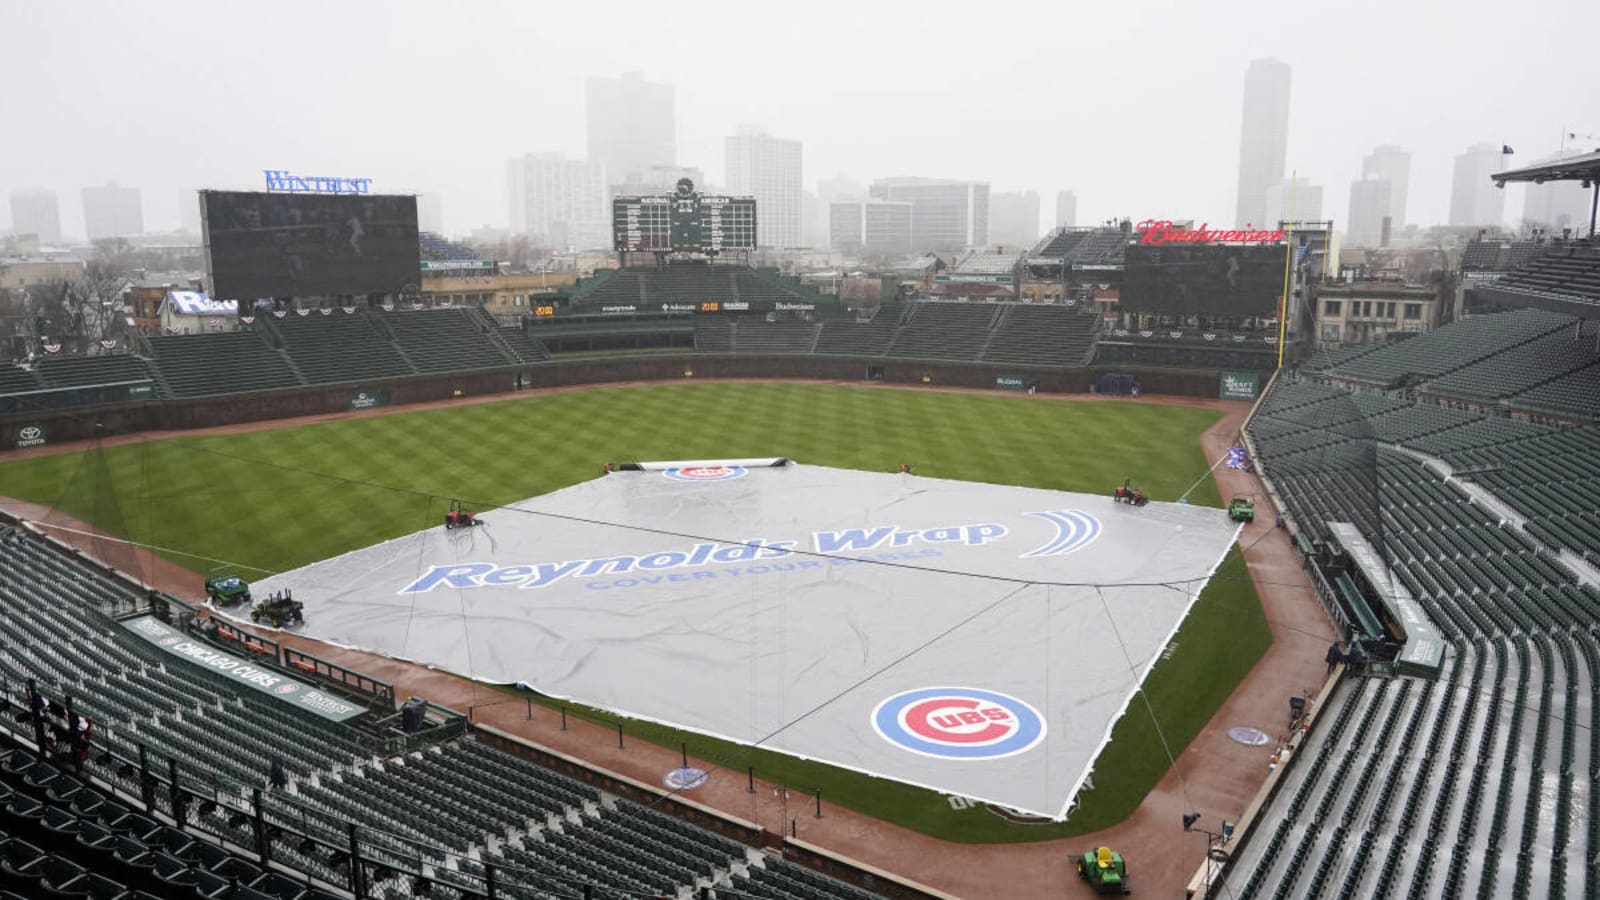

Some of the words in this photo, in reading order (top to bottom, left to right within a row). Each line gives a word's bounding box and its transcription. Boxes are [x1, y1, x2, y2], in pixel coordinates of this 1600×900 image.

[1136, 220, 1286, 245] Budweiser
[18, 438, 46, 447] TOYOTA
[397, 537, 797, 594] Reynolds
[814, 522, 1008, 553] Wrap
[585, 569, 716, 591] COVER
[721, 559, 823, 577] YOUR
[173, 642, 240, 670] CHICAGO
[232, 666, 281, 688] CUBS
